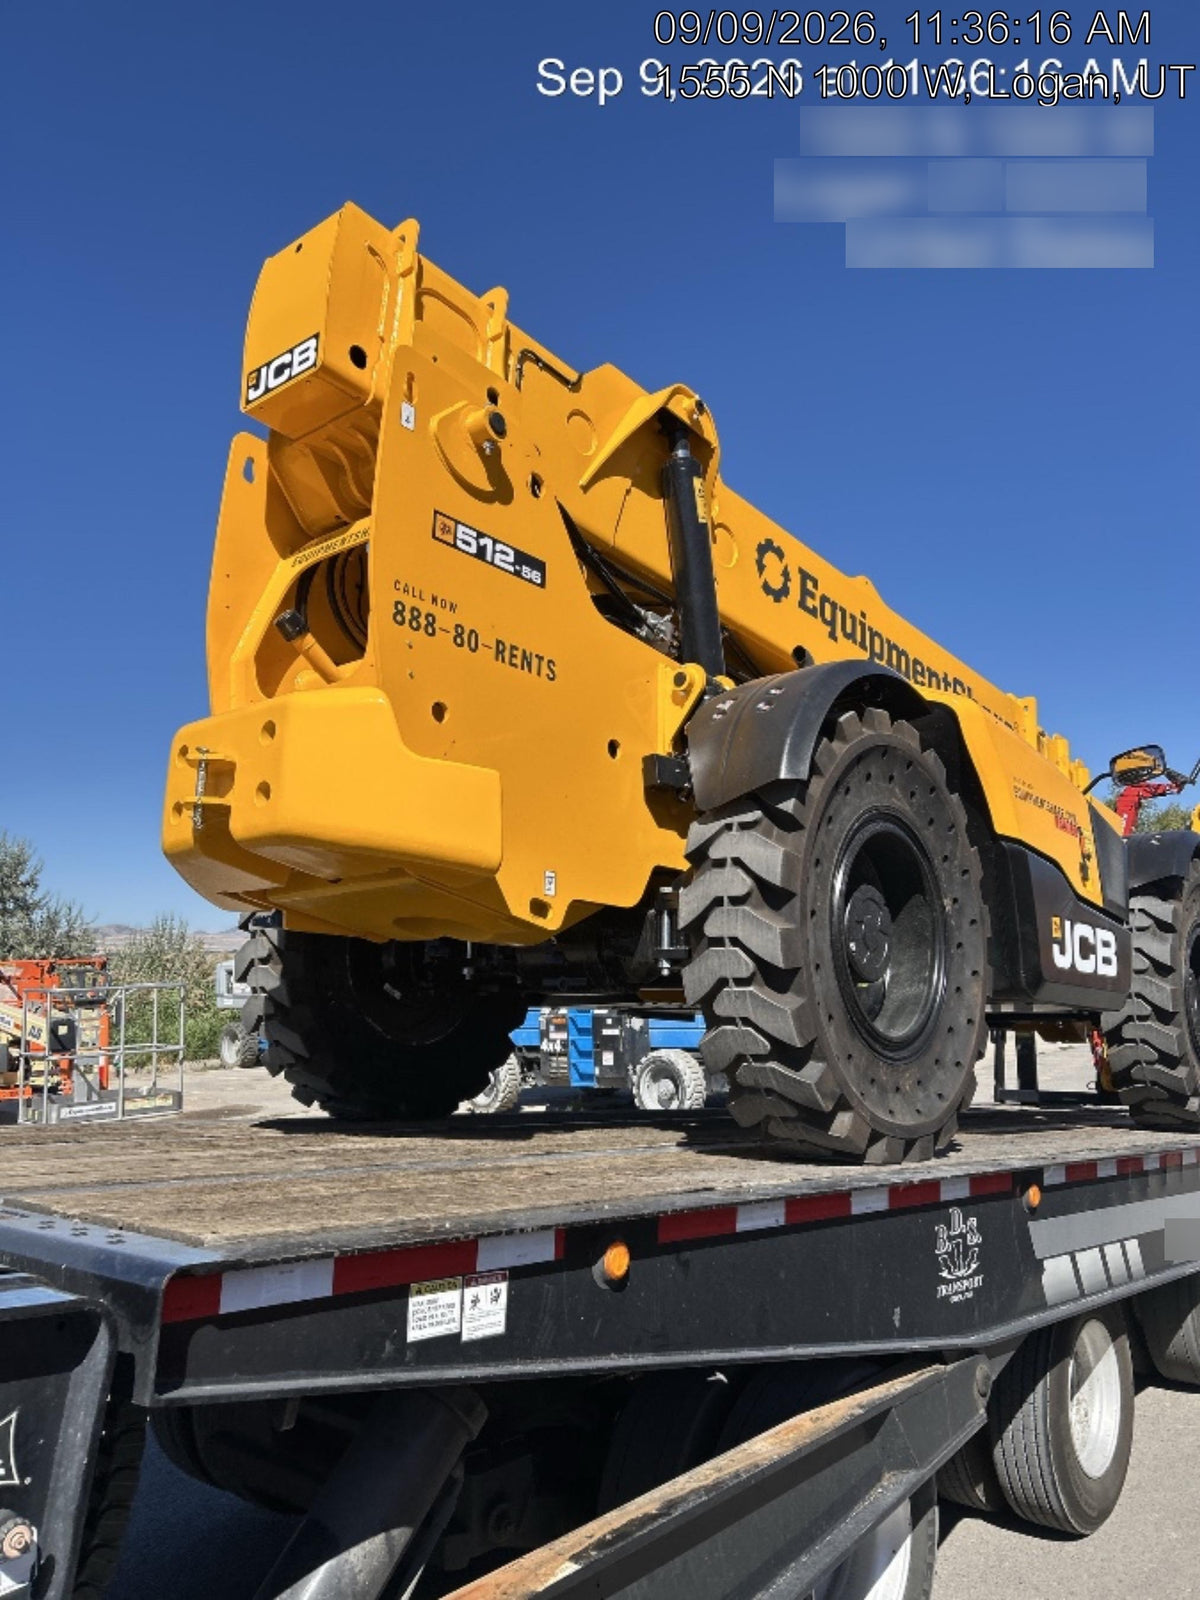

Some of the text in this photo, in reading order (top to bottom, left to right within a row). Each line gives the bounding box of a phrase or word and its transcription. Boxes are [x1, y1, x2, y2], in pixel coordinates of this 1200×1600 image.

[247, 337, 318, 402] JCB
[394, 579, 458, 614] CALL NOW
[392, 600, 557, 682] 888-80-RENTS
[1052, 919, 1118, 977] JCB
[936, 1274, 984, 1299] TRANSPORT
